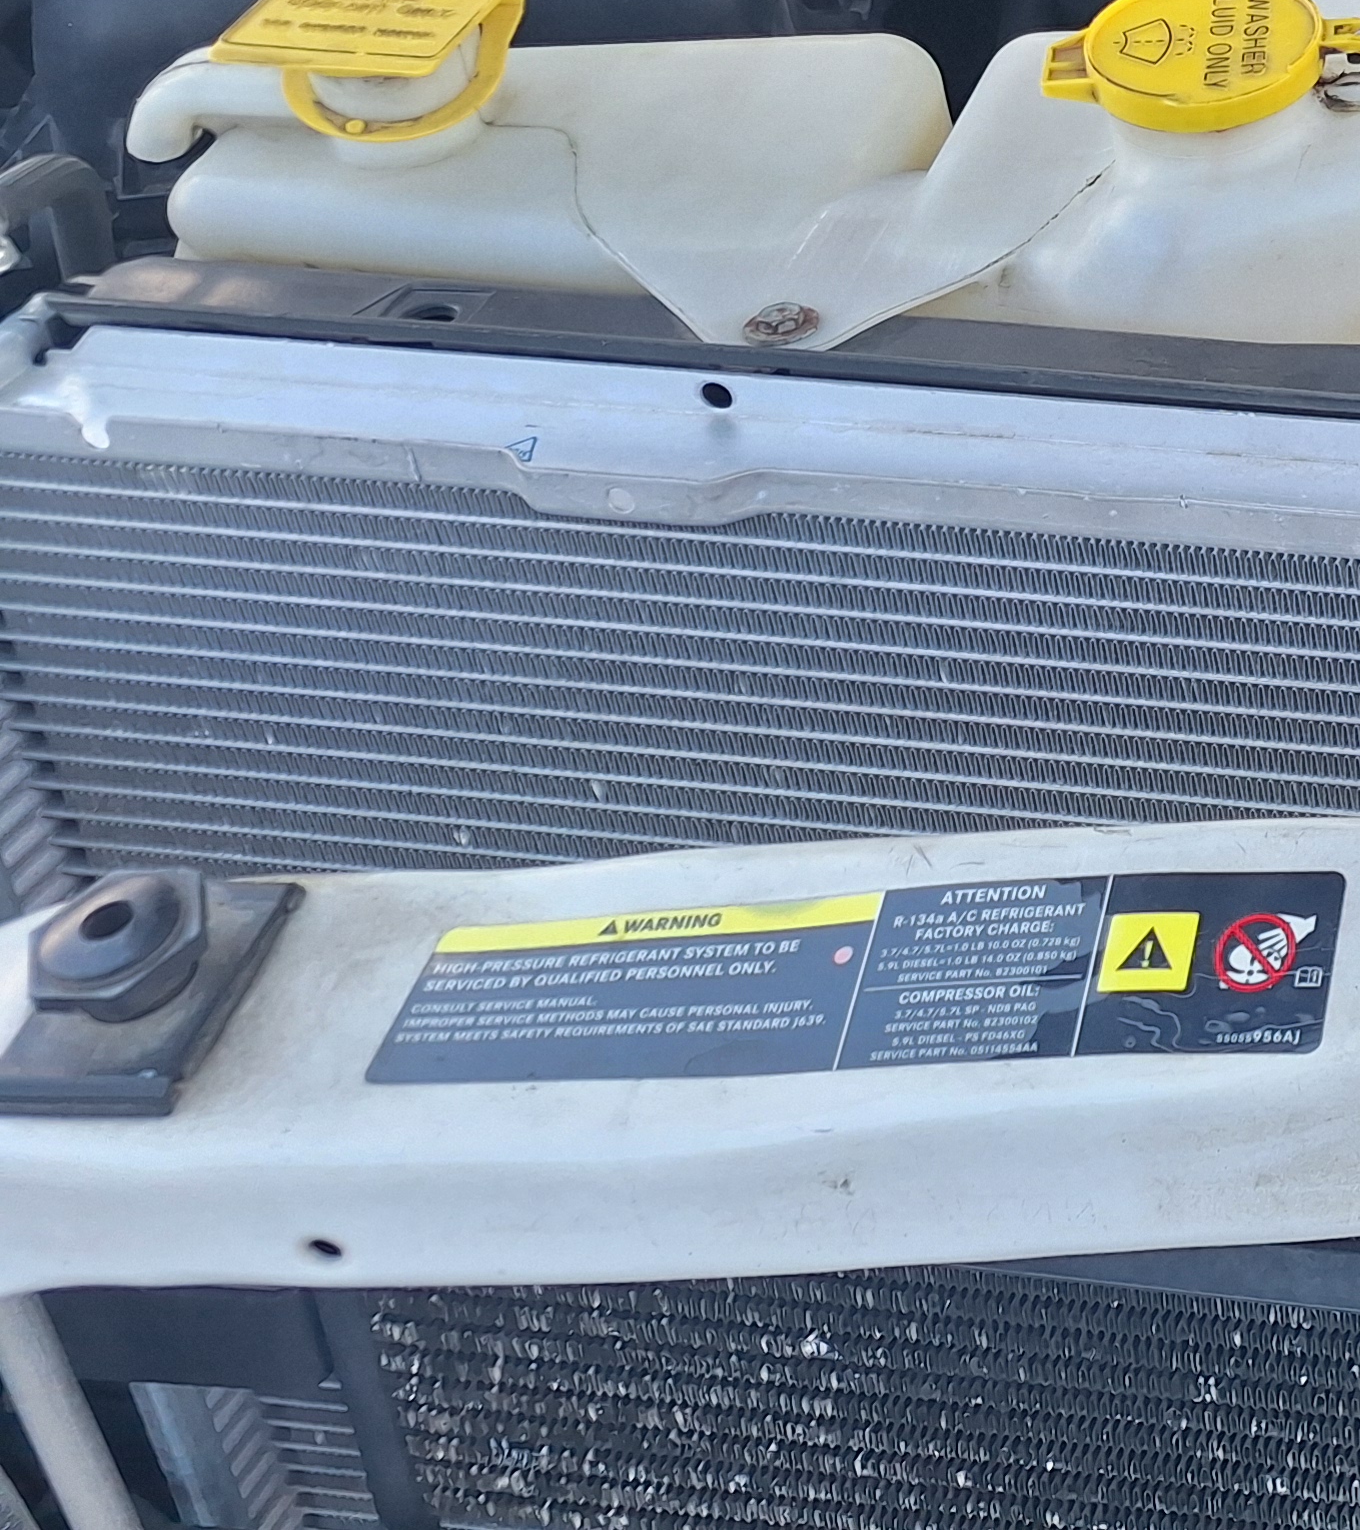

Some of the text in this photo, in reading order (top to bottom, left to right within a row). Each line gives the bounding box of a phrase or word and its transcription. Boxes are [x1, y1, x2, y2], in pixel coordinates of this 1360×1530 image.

[1202, 43, 1233, 91] ONLY
[940, 884, 1047, 906] ATTENTION
[623, 912, 723, 934] WARNING
[947, 908, 978, 925] A/C
[980, 903, 1086, 922] REFRIGERANT
[914, 920, 1054, 941] FACTORY CHARGE:
[1011, 938, 1026, 949] OZ
[432, 938, 801, 975] HIGH-PRESSURE REFRIGERANT SYSTEM TO BE
[1006, 952, 1021, 962] OZ
[423, 960, 777, 993] SERVICED BY QUALIFIED PERSONNEL ONLY.
[897, 971, 943, 983] SERVICE
[945, 969, 972, 980] PART
[899, 986, 1005, 1005] COMPRESSOR
[402, 999, 814, 1029] IMPROPER SERVICE METHODS MAY CAUSE PERSONAL INJURY.
[410, 1002, 474, 1015] CONSULT
[476, 999, 533, 1013] SERVICE
[394, 1030, 450, 1043] SYSTEM
[452, 1028, 498, 1042] MEETS
[500, 1026, 552, 1040] SAFETY
[554, 1020, 662, 1039] REQUIREMENTS
[665, 1021, 683, 1034] OF
[687, 1020, 714, 1033] SAE
[716, 1017, 789, 1032] STANDARD
[884, 1022, 930, 1034] SERVICE
[933, 1020, 960, 1031] PART
[869, 1050, 917, 1062] SERVICE
[918, 1048, 946, 1060] PART
